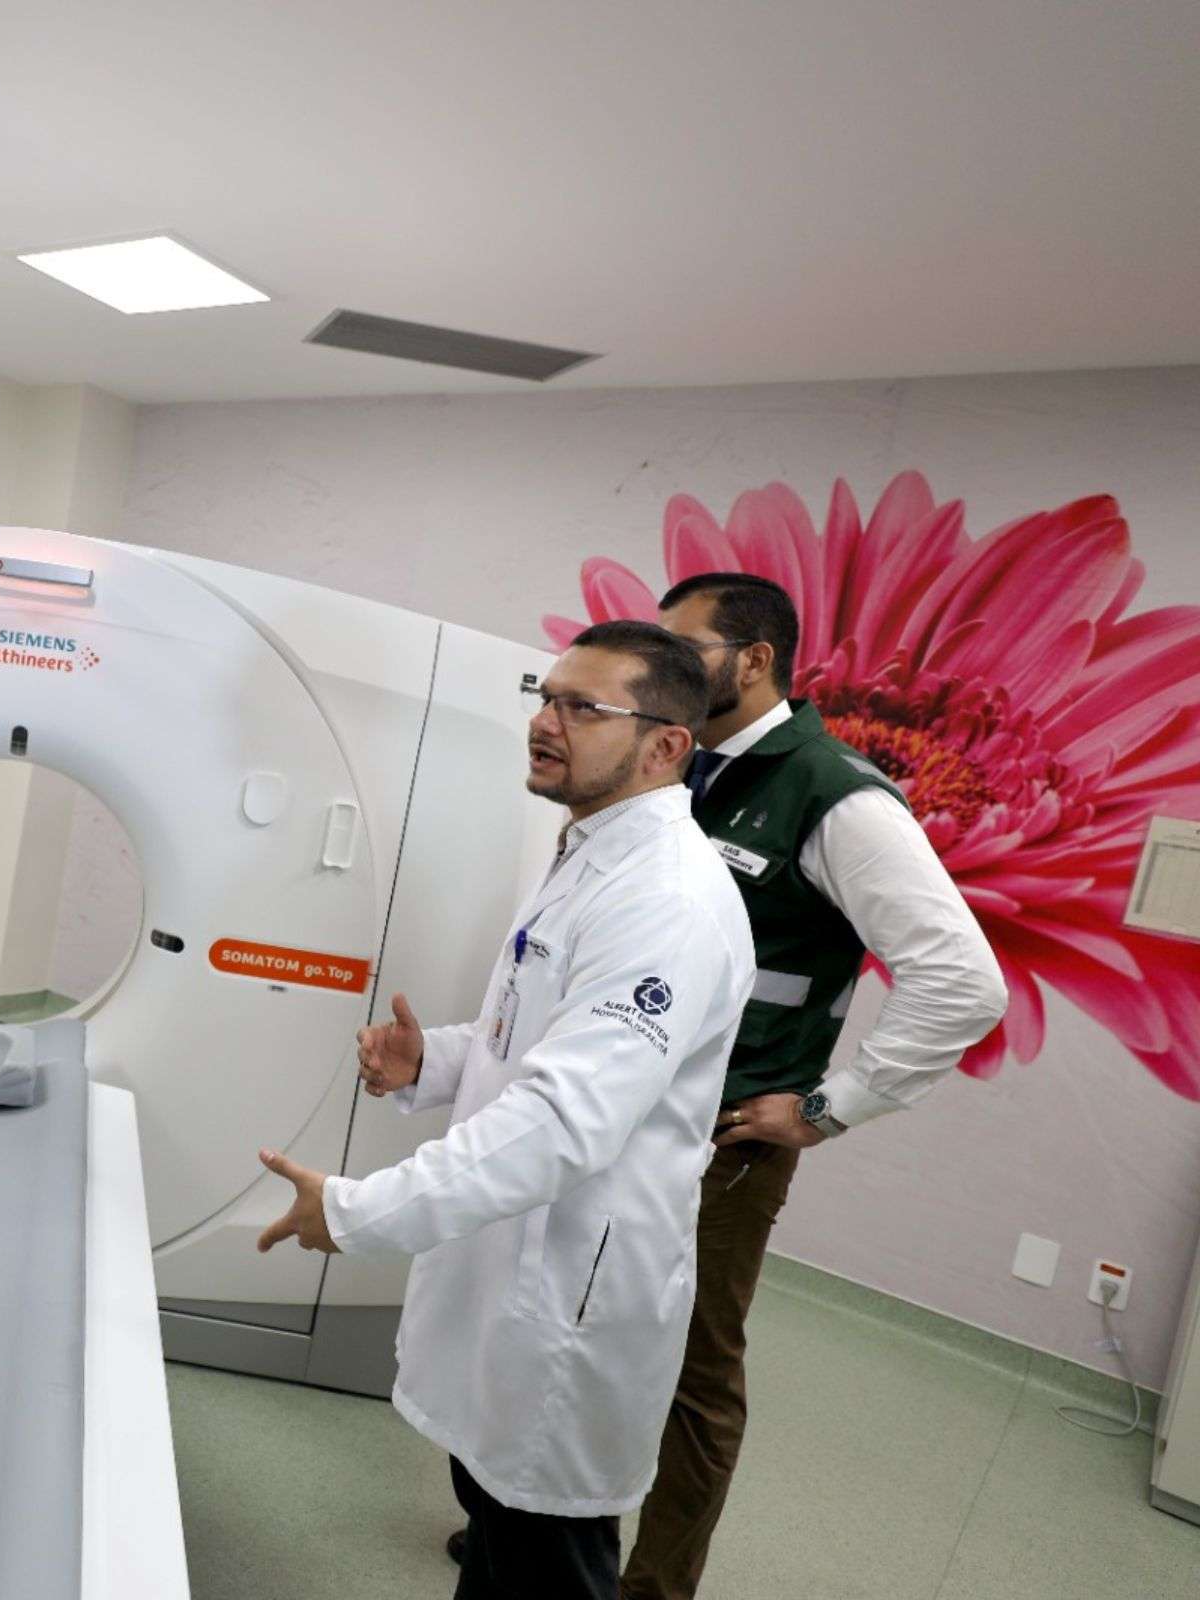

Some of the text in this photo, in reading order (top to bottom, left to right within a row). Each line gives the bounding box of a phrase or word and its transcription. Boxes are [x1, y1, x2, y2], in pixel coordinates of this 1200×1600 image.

[220, 949, 354, 983] SOMATOM go. Top
